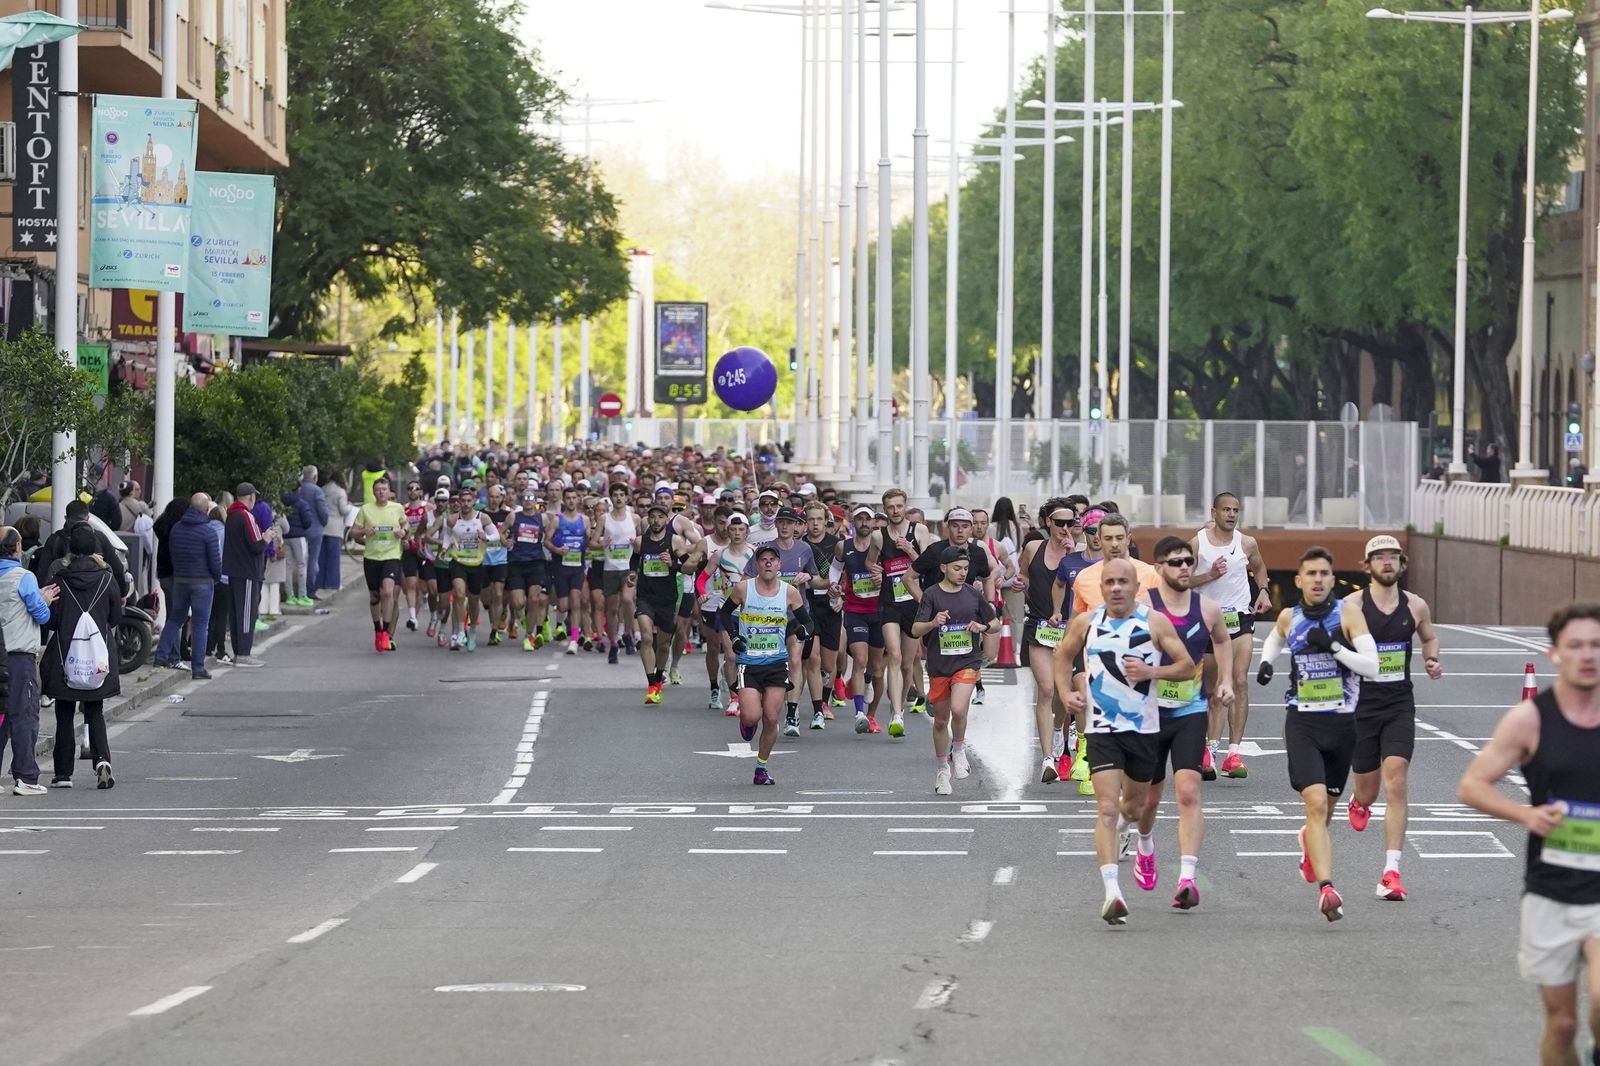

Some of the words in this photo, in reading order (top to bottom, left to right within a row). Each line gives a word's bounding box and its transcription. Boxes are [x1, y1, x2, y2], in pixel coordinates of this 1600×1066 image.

[97, 209, 186, 232] SEVILLA
[204, 256, 239, 264] SEVILLA
[726, 368, 746, 387] 2:45
[668, 384, 701, 397] 8:55
[944, 640, 970, 648] ANTOINE
[1311, 670, 1337, 678] ZURICH
[1162, 689, 1179, 698] ASA
